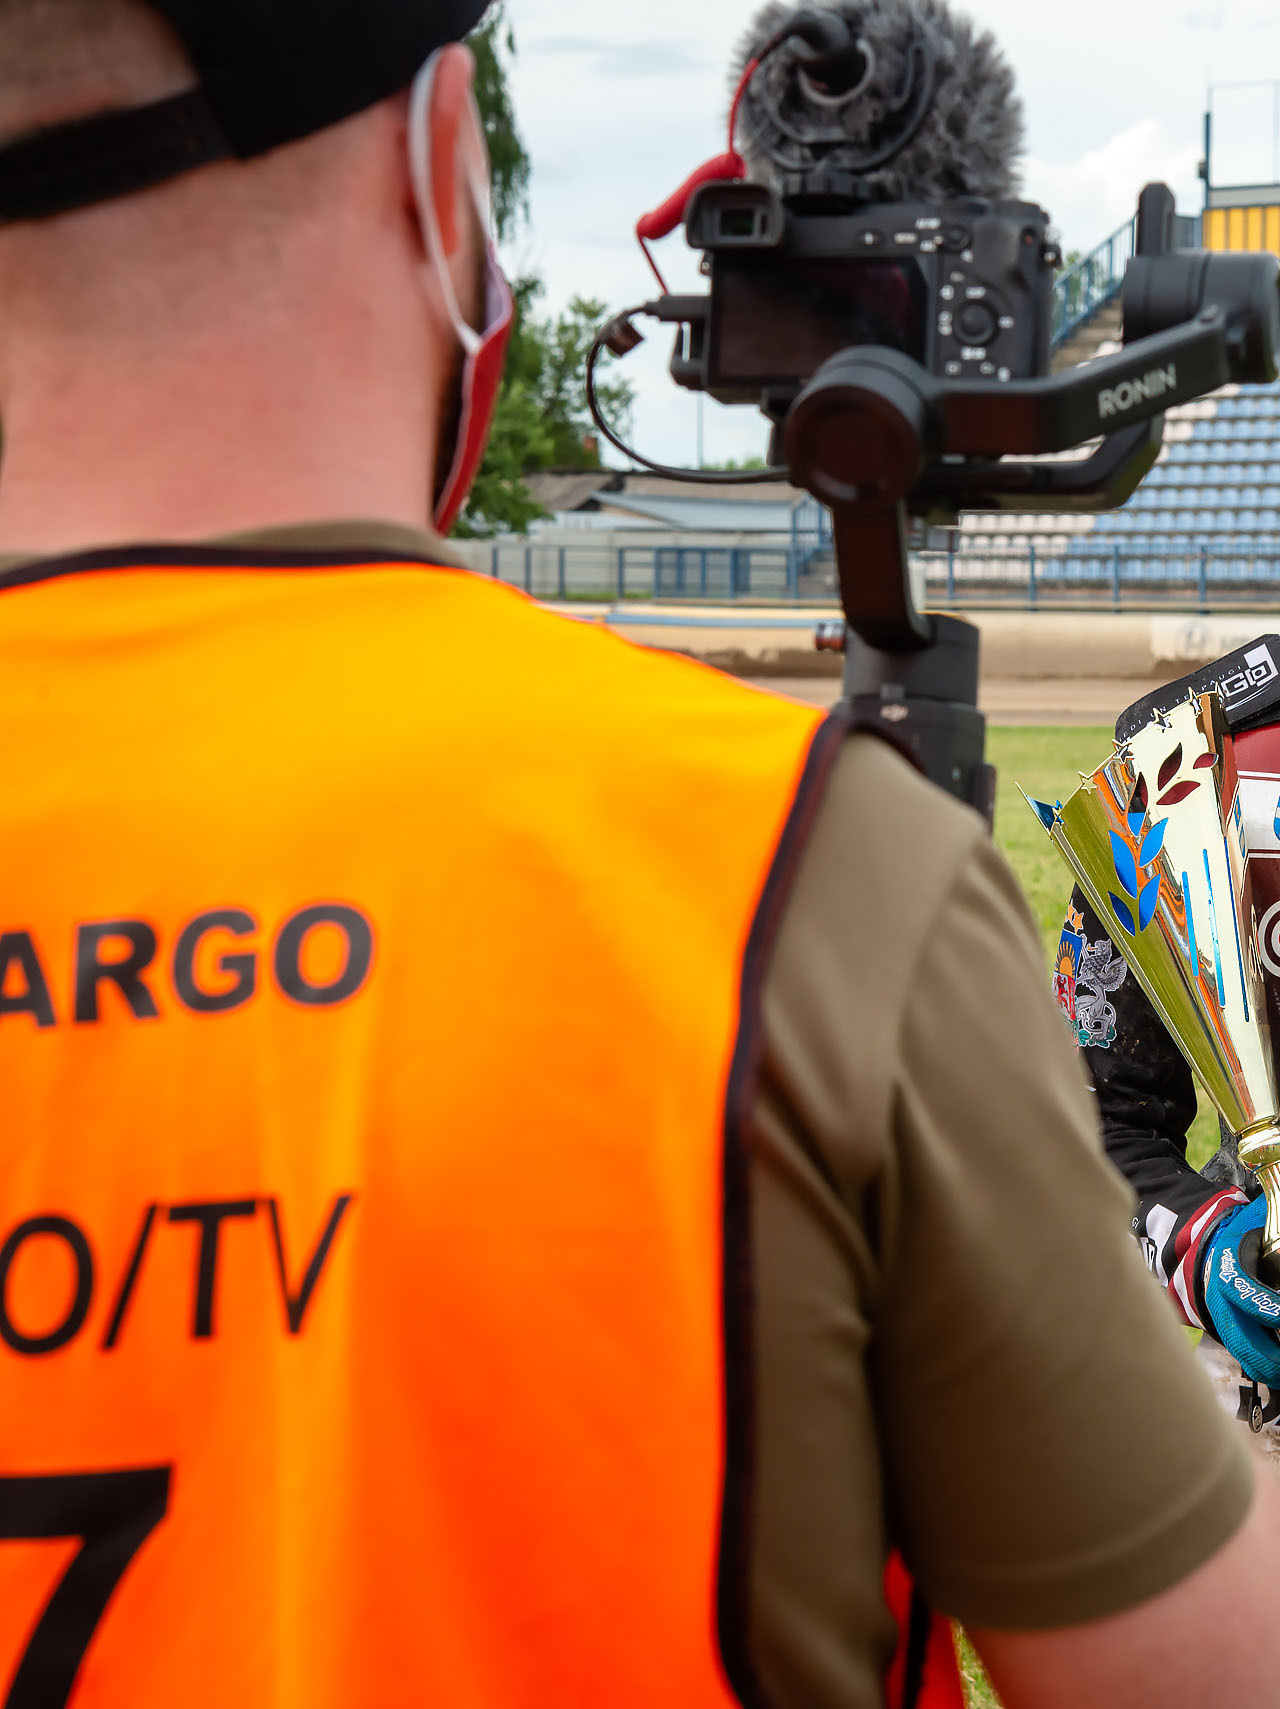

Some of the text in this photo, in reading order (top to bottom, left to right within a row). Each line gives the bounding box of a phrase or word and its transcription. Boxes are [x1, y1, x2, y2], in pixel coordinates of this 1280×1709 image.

[1098, 362, 1177, 418] RONIN
[0, 903, 374, 1028] ARGO
[0, 1195, 353, 1356] O/TV
[1234, 1277, 1280, 1317] Troy Lee
[0, 1464, 174, 1709] 7
